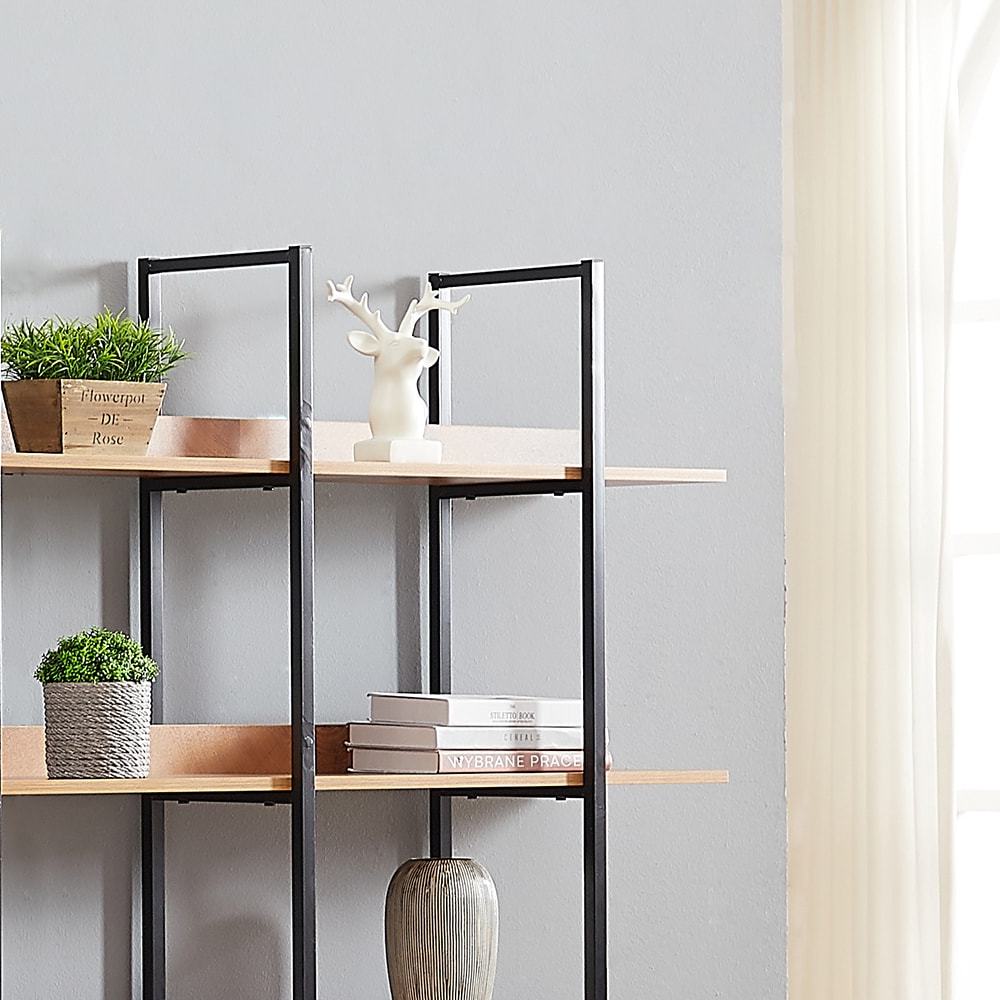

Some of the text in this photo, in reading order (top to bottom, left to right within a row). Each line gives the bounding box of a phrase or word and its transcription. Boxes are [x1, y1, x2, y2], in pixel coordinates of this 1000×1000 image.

[80, 389, 145, 407] Flowerpot
[92, 432, 124, 445] Rose
[449, 754, 582, 769] WYBRANE PRACE
